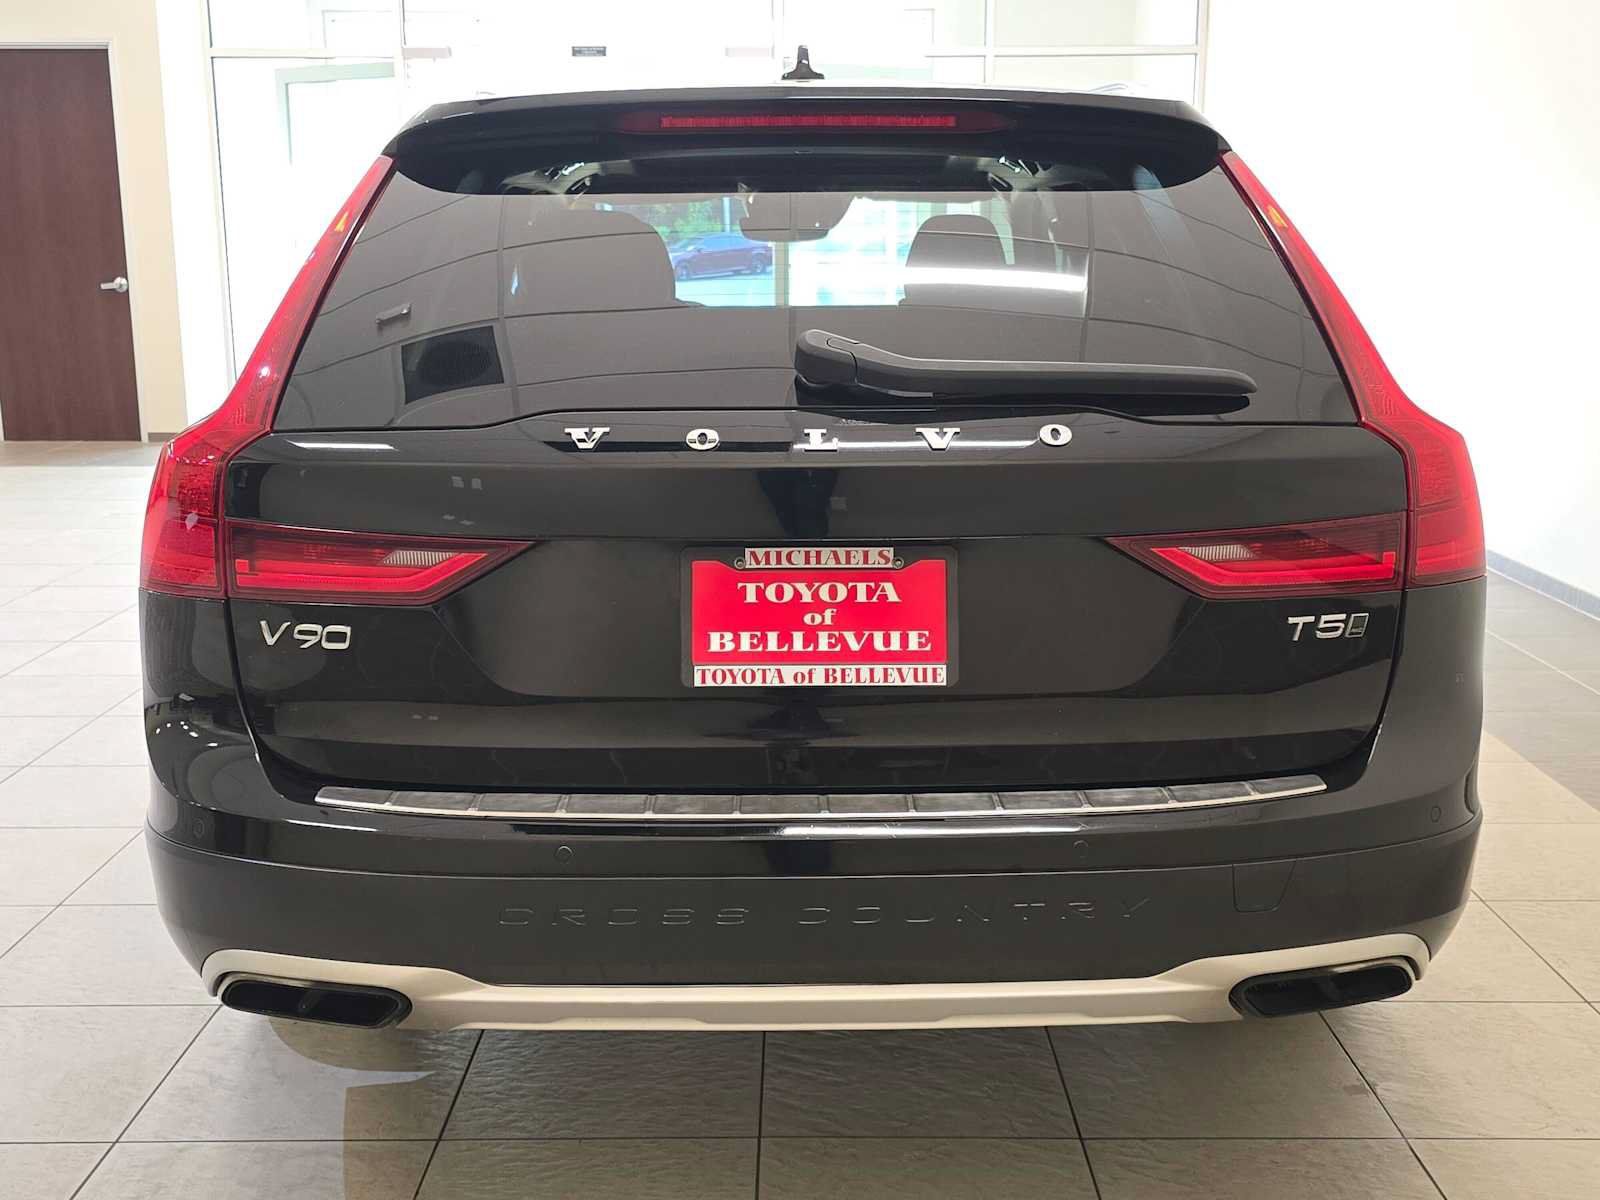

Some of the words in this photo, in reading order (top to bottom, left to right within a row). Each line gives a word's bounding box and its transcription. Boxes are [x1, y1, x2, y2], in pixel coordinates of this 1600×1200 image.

[564, 424, 1073, 451] VOLVO
[748, 549, 892, 566] MICHAELS
[737, 581, 902, 604] TOYOTA
[803, 608, 837, 626] of
[260, 620, 352, 650] V90
[707, 630, 932, 653] BELLEVUE
[696, 668, 785, 685] TOYOTA
[793, 668, 816, 685] of
[824, 667, 945, 684] BELLEVUE
[500, 908, 750, 926] CROSS
[798, 898, 1149, 925] COUNTRY
